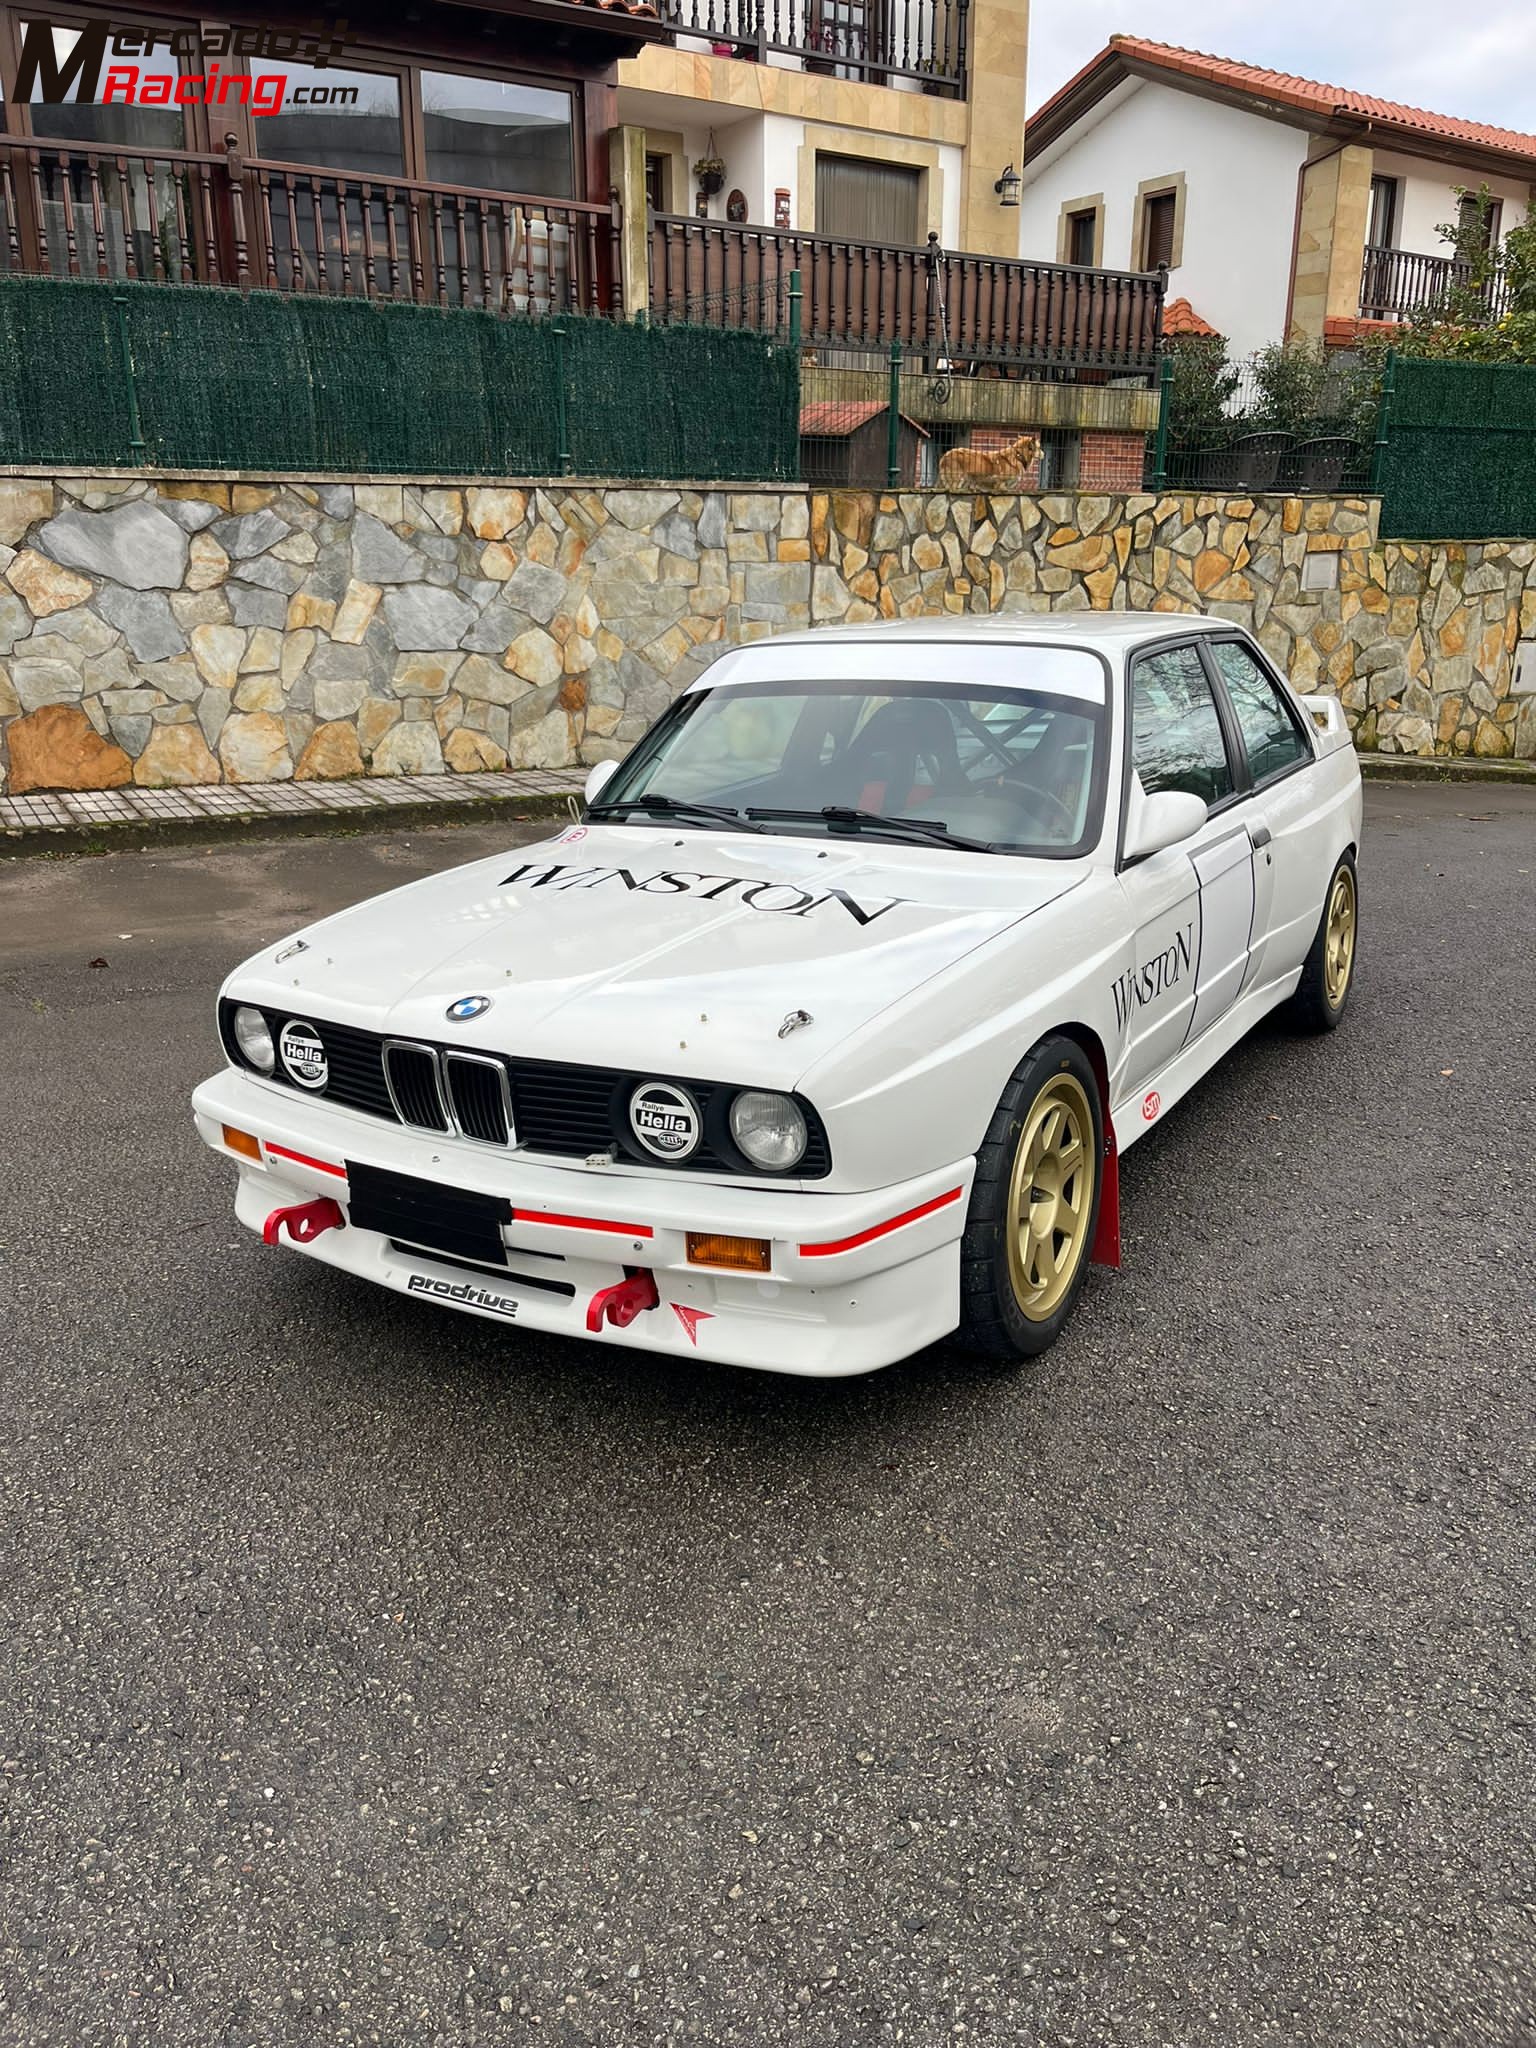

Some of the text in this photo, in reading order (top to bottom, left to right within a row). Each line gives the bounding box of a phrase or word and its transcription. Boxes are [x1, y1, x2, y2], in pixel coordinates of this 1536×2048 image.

[497, 864, 917, 926] WINSTON
[1110, 922, 1193, 1033] WINSTON
[287, 1043, 322, 1062] Hella
[640, 1110, 687, 1131] Hella
[641, 1102, 665, 1111] Rallye
[407, 1274, 519, 1313] prodrive
